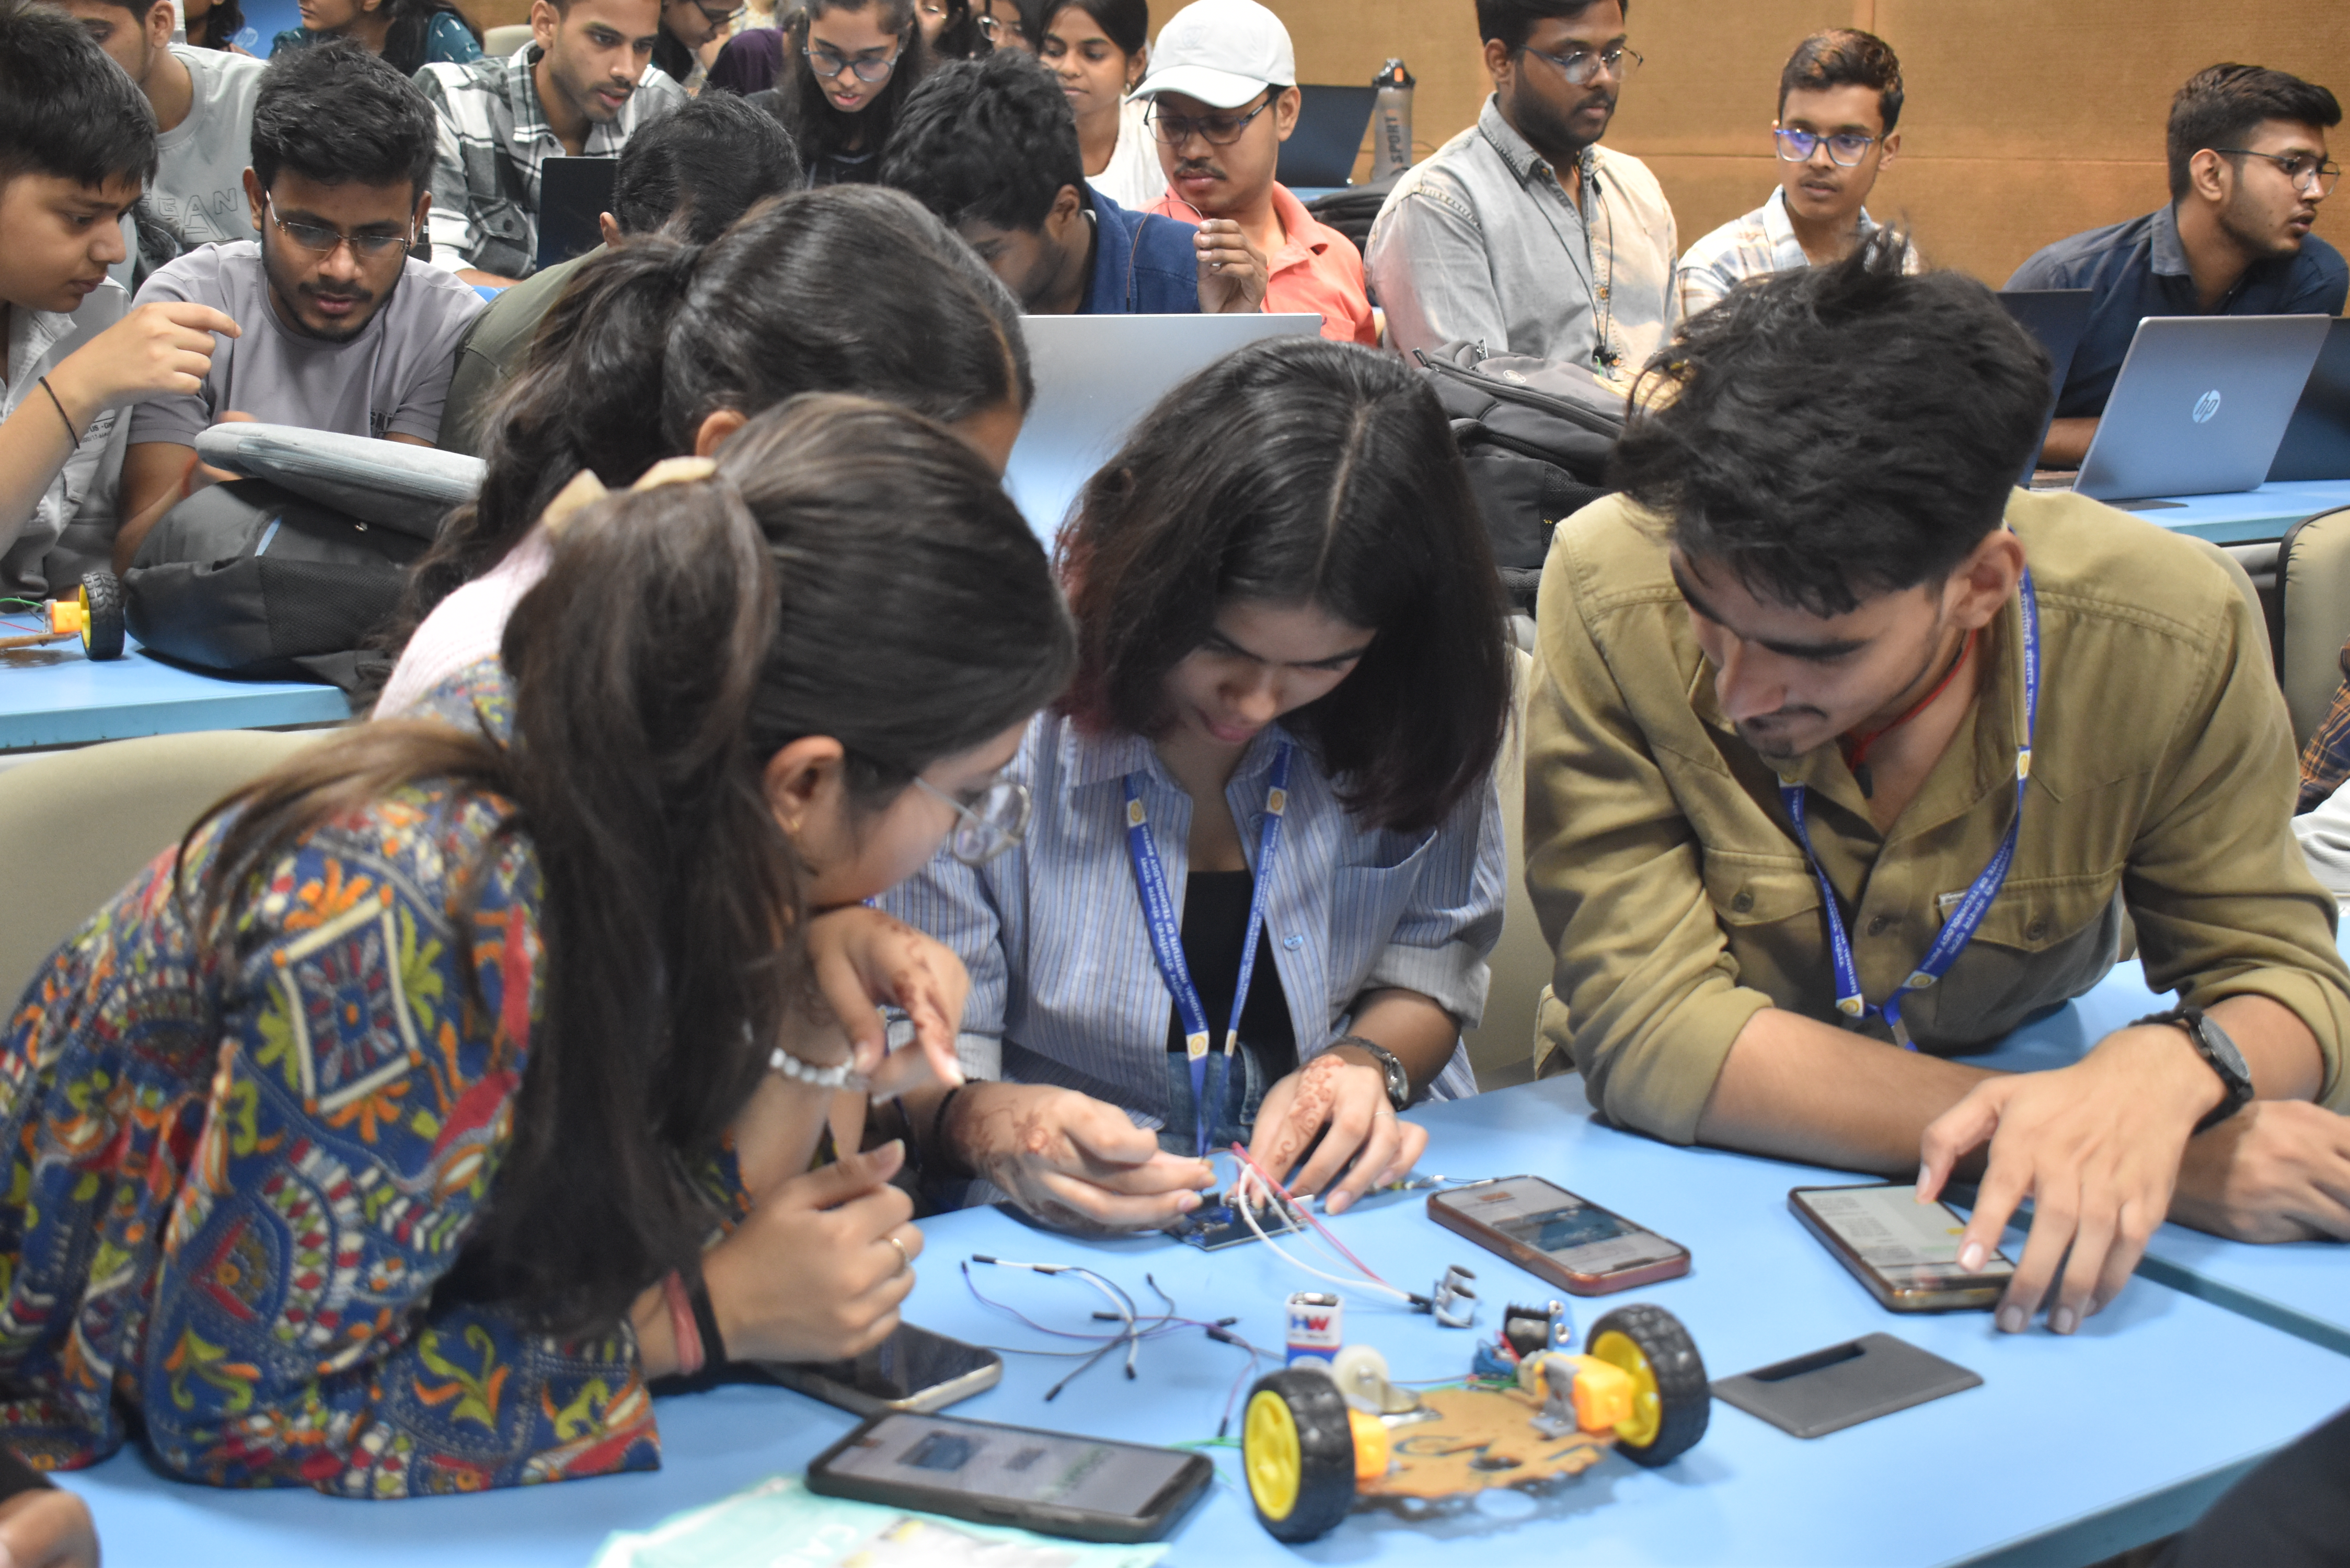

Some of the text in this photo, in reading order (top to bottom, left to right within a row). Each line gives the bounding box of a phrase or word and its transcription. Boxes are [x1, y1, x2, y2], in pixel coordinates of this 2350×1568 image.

[2194, 390, 2220, 423] hp
[1149, 857, 1171, 919] TECHNOLOGY
[1977, 875, 1989, 890] OF
[1165, 921, 1174, 934] OF
[1938, 889, 1979, 948] TECHNOLOGY
[1169, 935, 1188, 984] INSTITUTE
[1843, 947, 1858, 994] NATIONAL
[1184, 985, 1205, 1030] NATIONAL
[1292, 1315, 1330, 1330] HW
